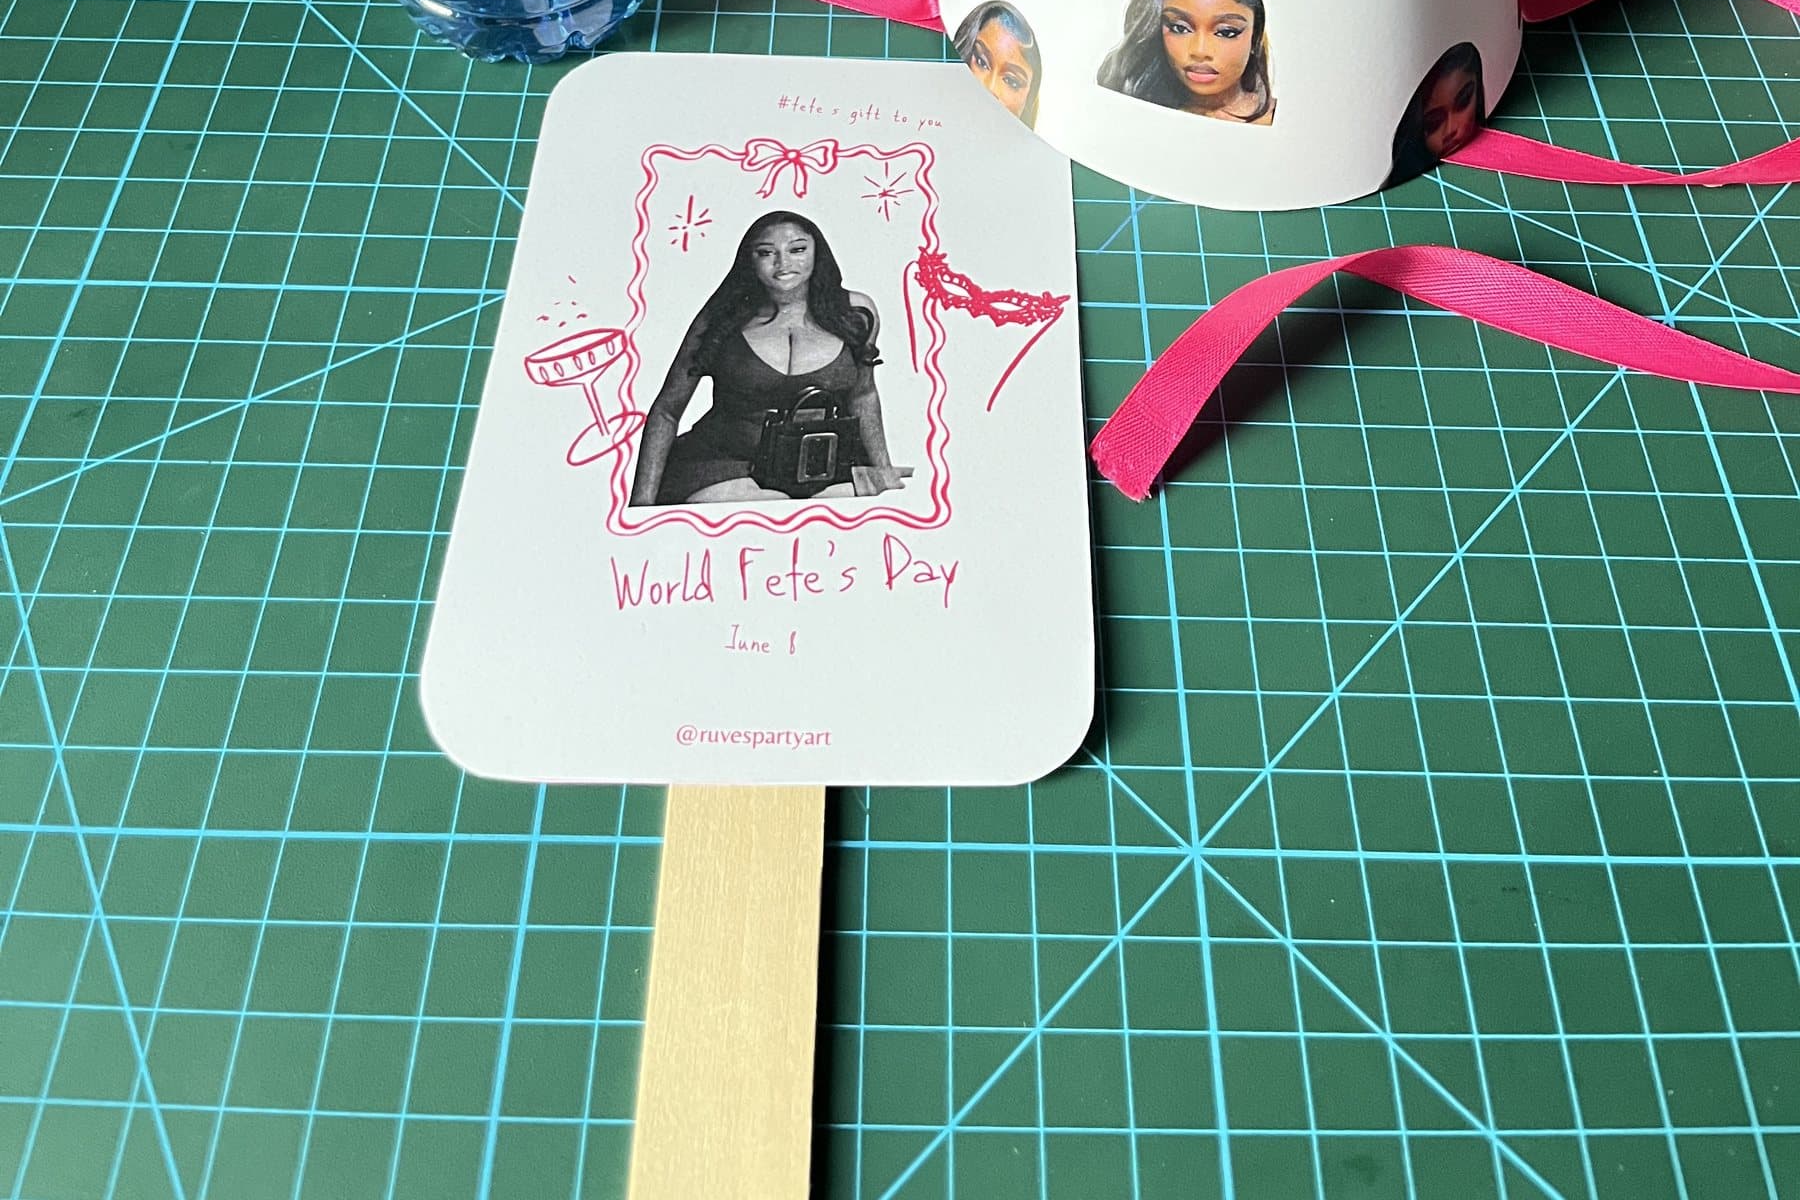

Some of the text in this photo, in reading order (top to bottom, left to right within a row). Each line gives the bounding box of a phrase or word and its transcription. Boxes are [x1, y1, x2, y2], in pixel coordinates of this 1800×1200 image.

[850, 104, 880, 125] gift
[893, 109, 908, 123] to
[919, 118, 943, 131] you
[611, 532, 959, 611] World Fete's Day
[724, 624, 770, 653] June
[676, 724, 832, 749] @ruvespartyart
